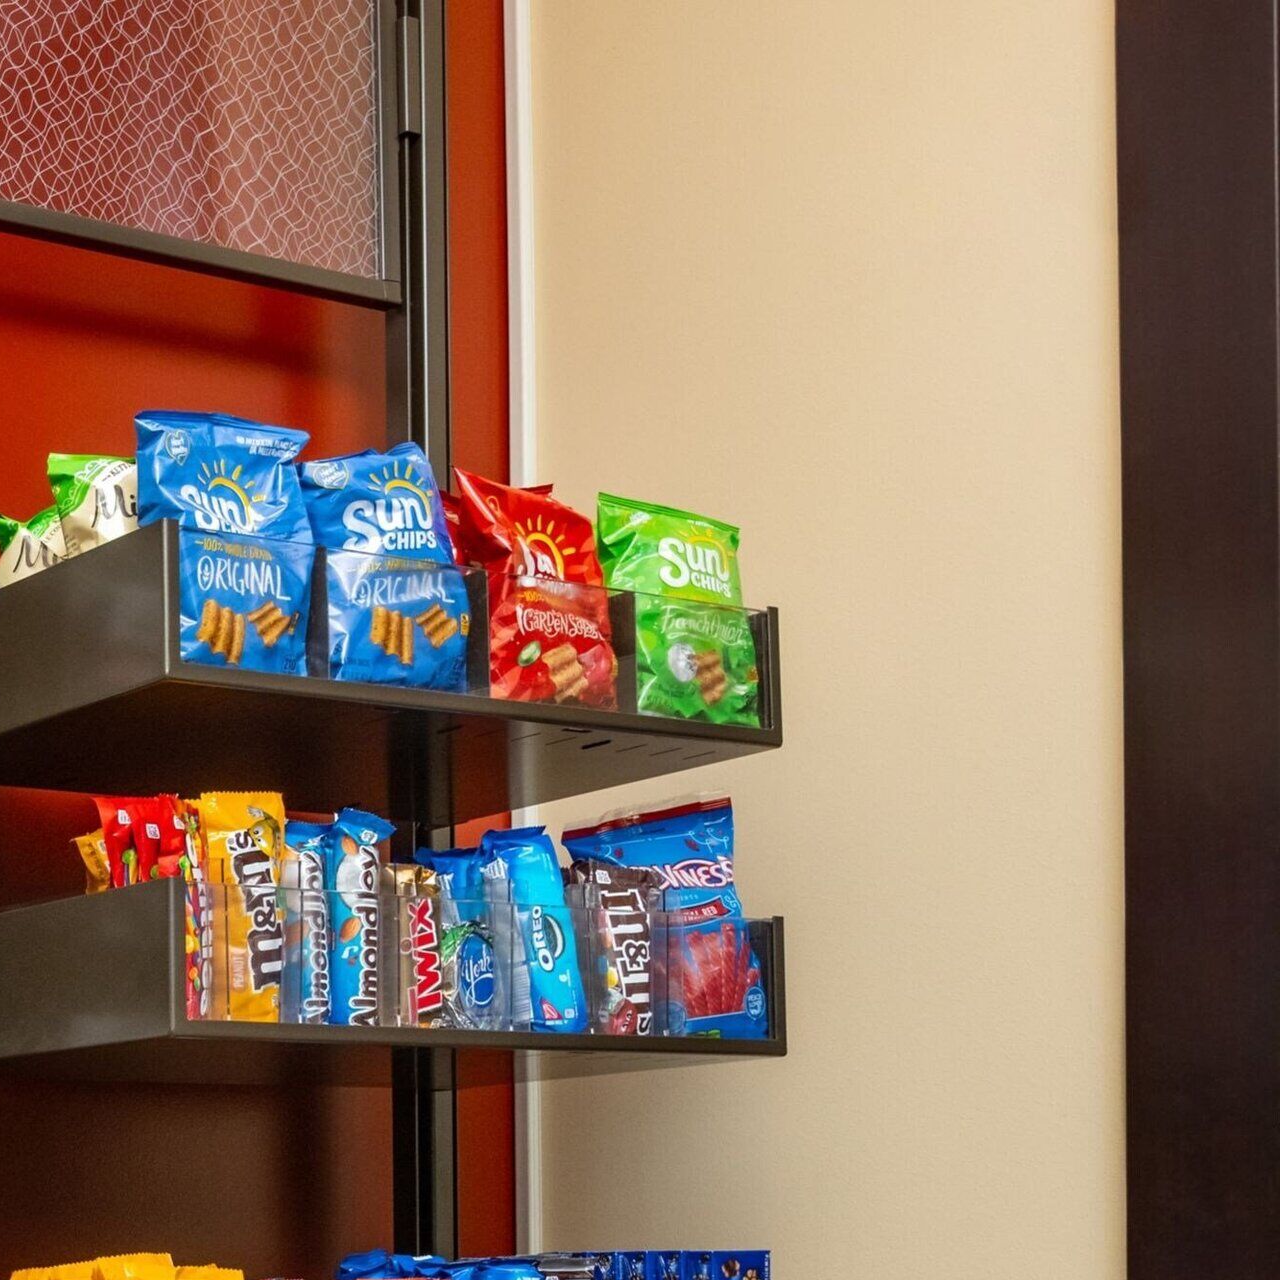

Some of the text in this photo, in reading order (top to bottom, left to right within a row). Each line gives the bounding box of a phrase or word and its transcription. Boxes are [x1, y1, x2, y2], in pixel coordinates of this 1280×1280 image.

[344, 497, 432, 552] Sun
[383, 529, 436, 549] CHIPS
[197, 557, 291, 600] ORIGINAL
[657, 537, 729, 587] Sun
[690, 574, 731, 598] CHIPS
[531, 906, 552, 970] OREO
